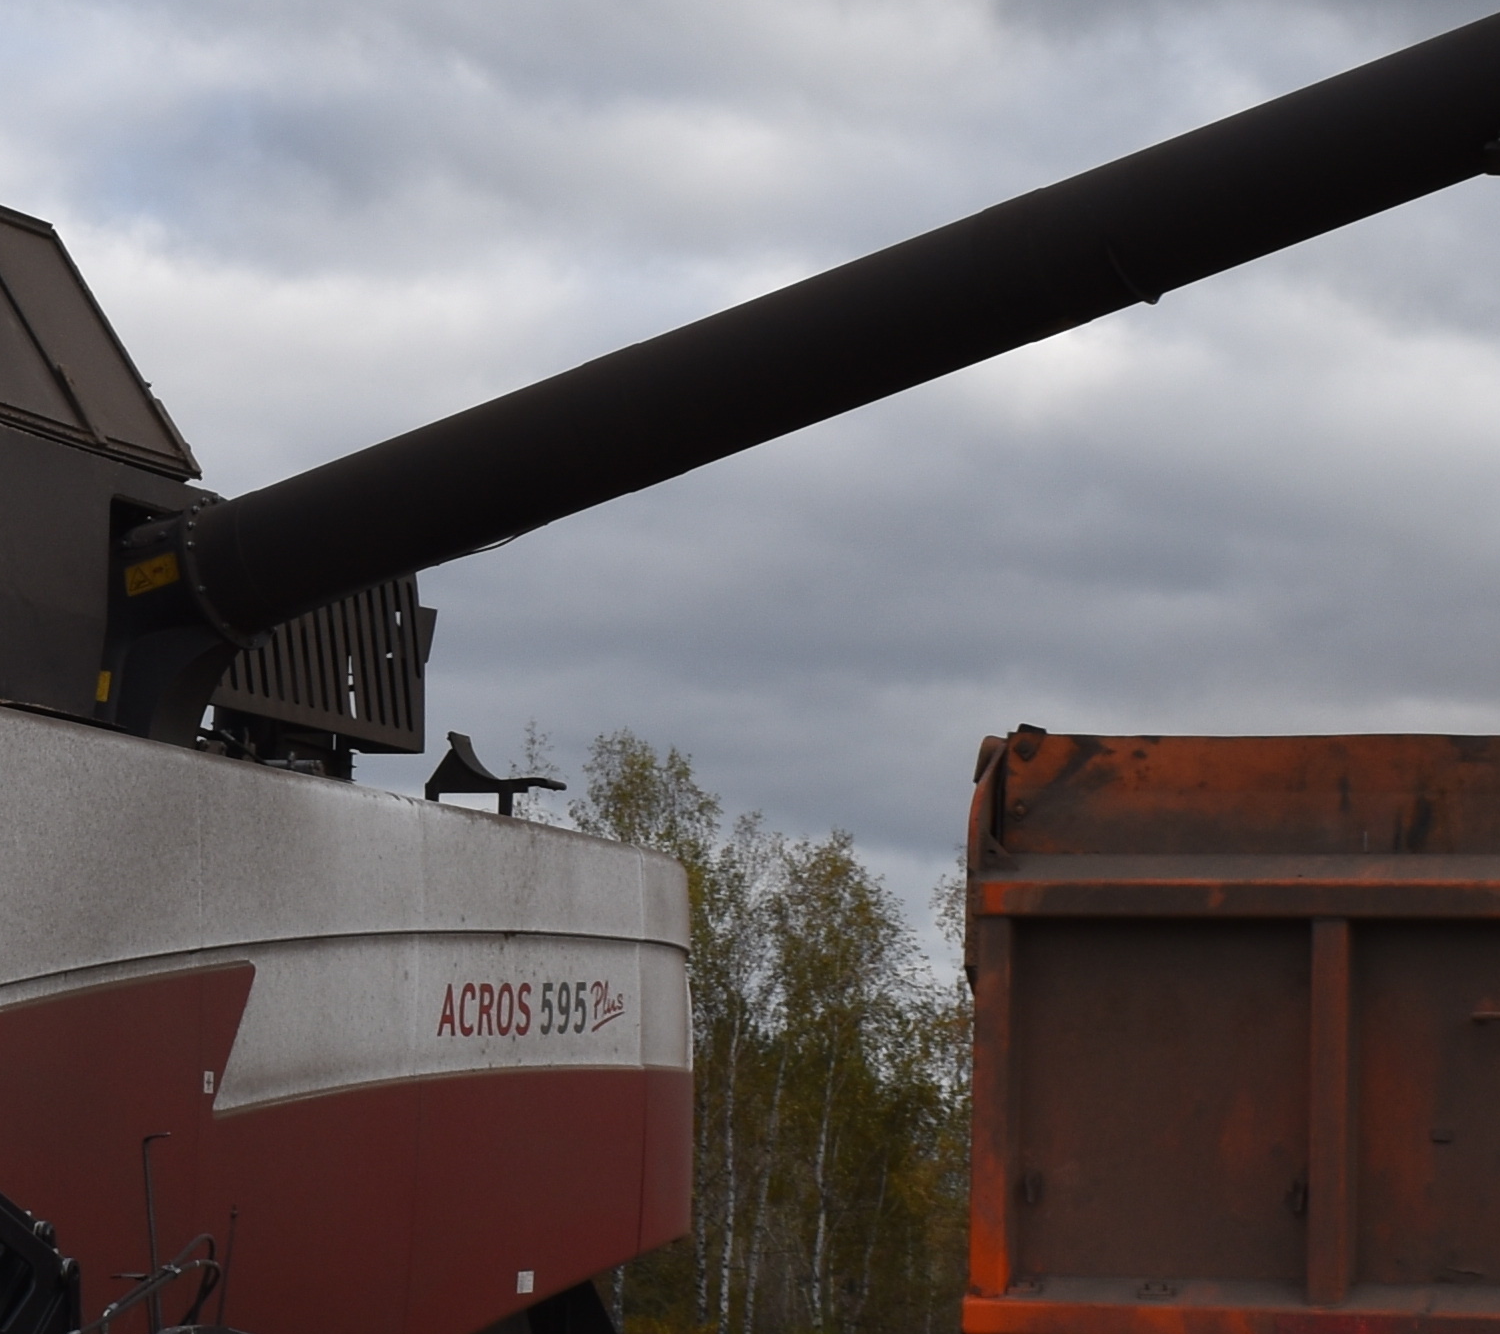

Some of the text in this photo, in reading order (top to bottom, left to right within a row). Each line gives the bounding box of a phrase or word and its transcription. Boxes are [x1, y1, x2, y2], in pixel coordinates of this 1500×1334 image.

[437, 980, 624, 1037] ACROS 595 Plus
